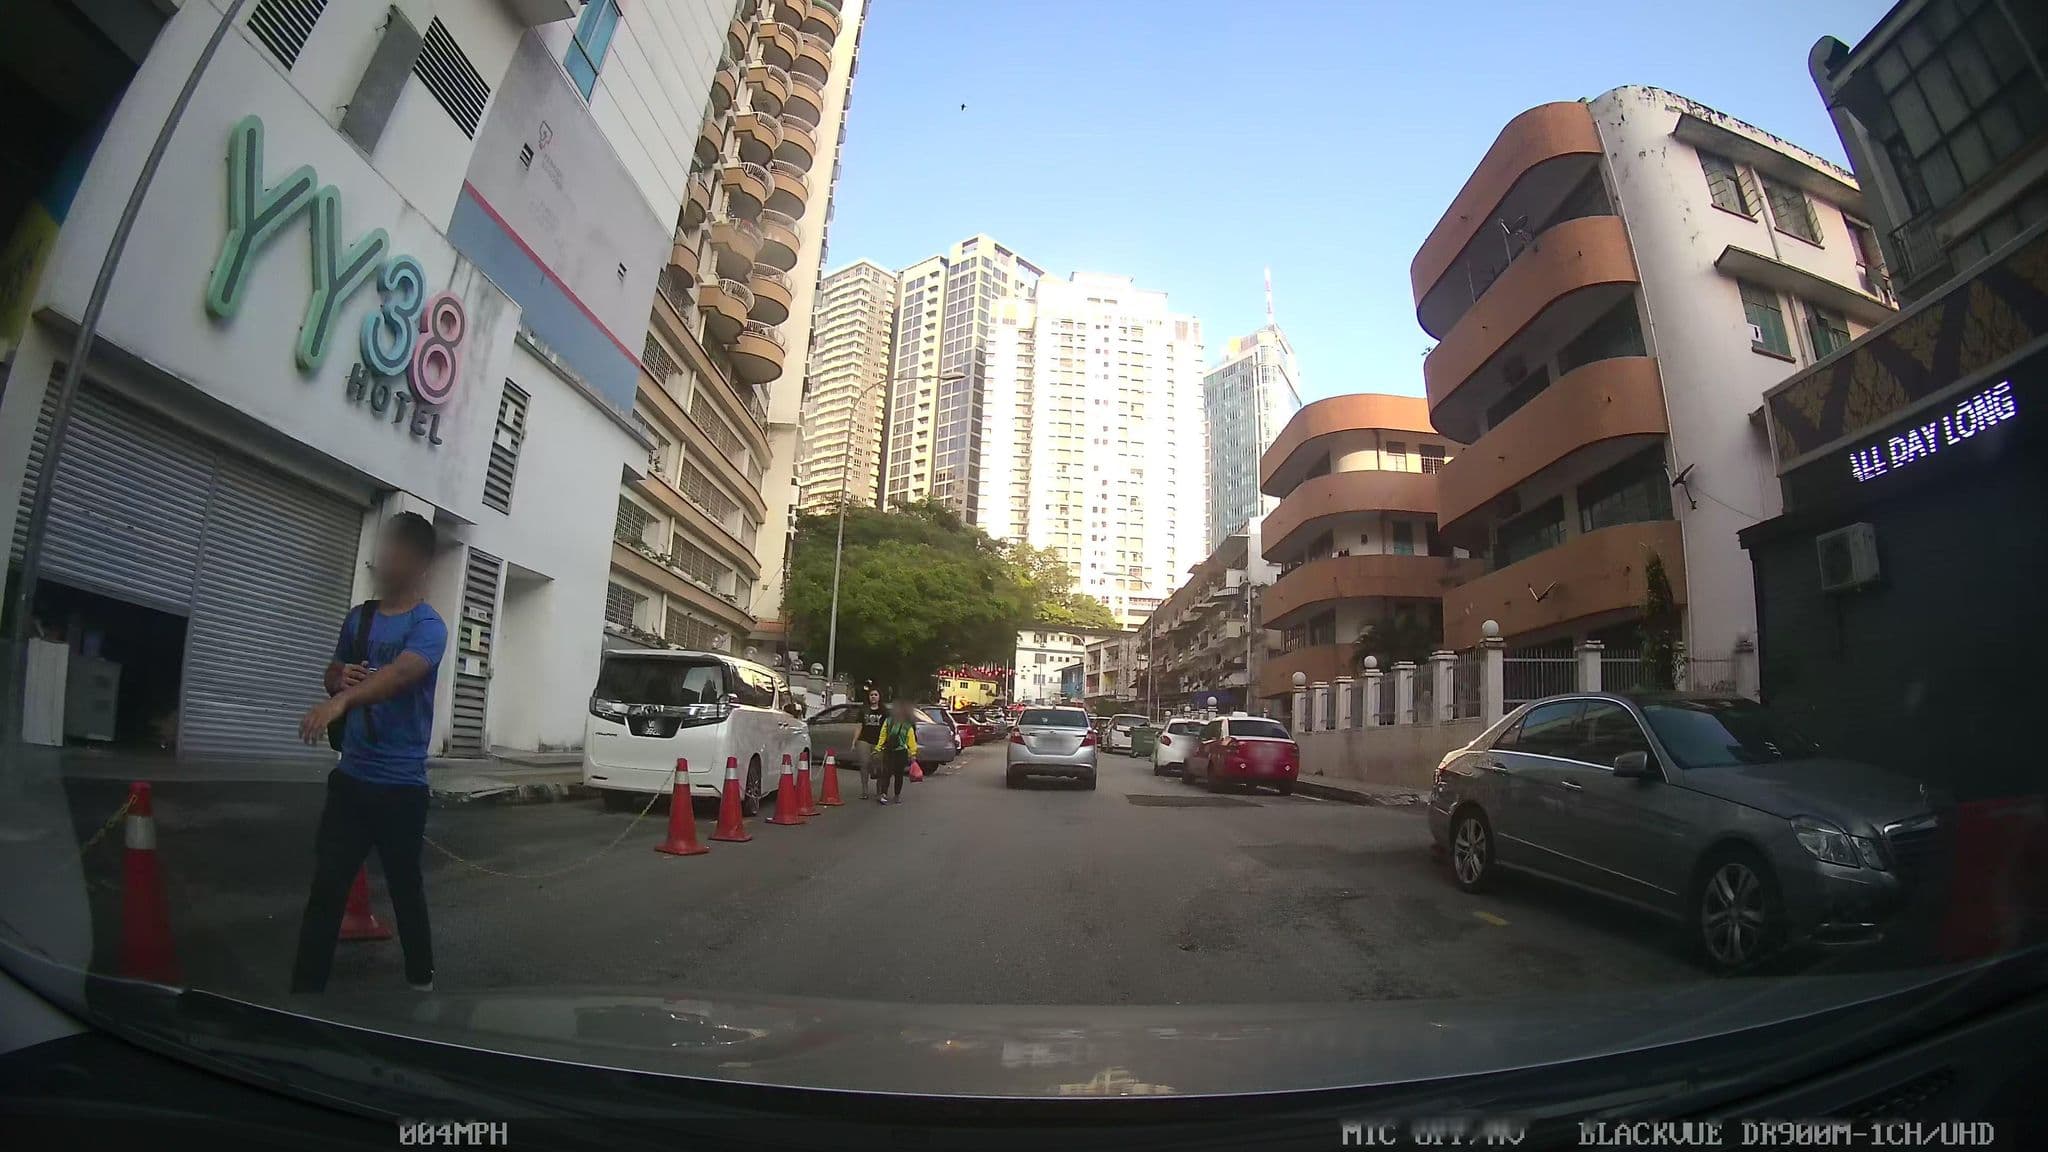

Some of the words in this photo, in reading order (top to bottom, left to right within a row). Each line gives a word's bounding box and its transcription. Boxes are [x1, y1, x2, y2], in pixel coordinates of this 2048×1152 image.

[205, 114, 468, 406] YY38
[345, 362, 443, 446] HOTEL
[1888, 421, 1937, 469] DAY
[1942, 380, 2017, 446] LONG
